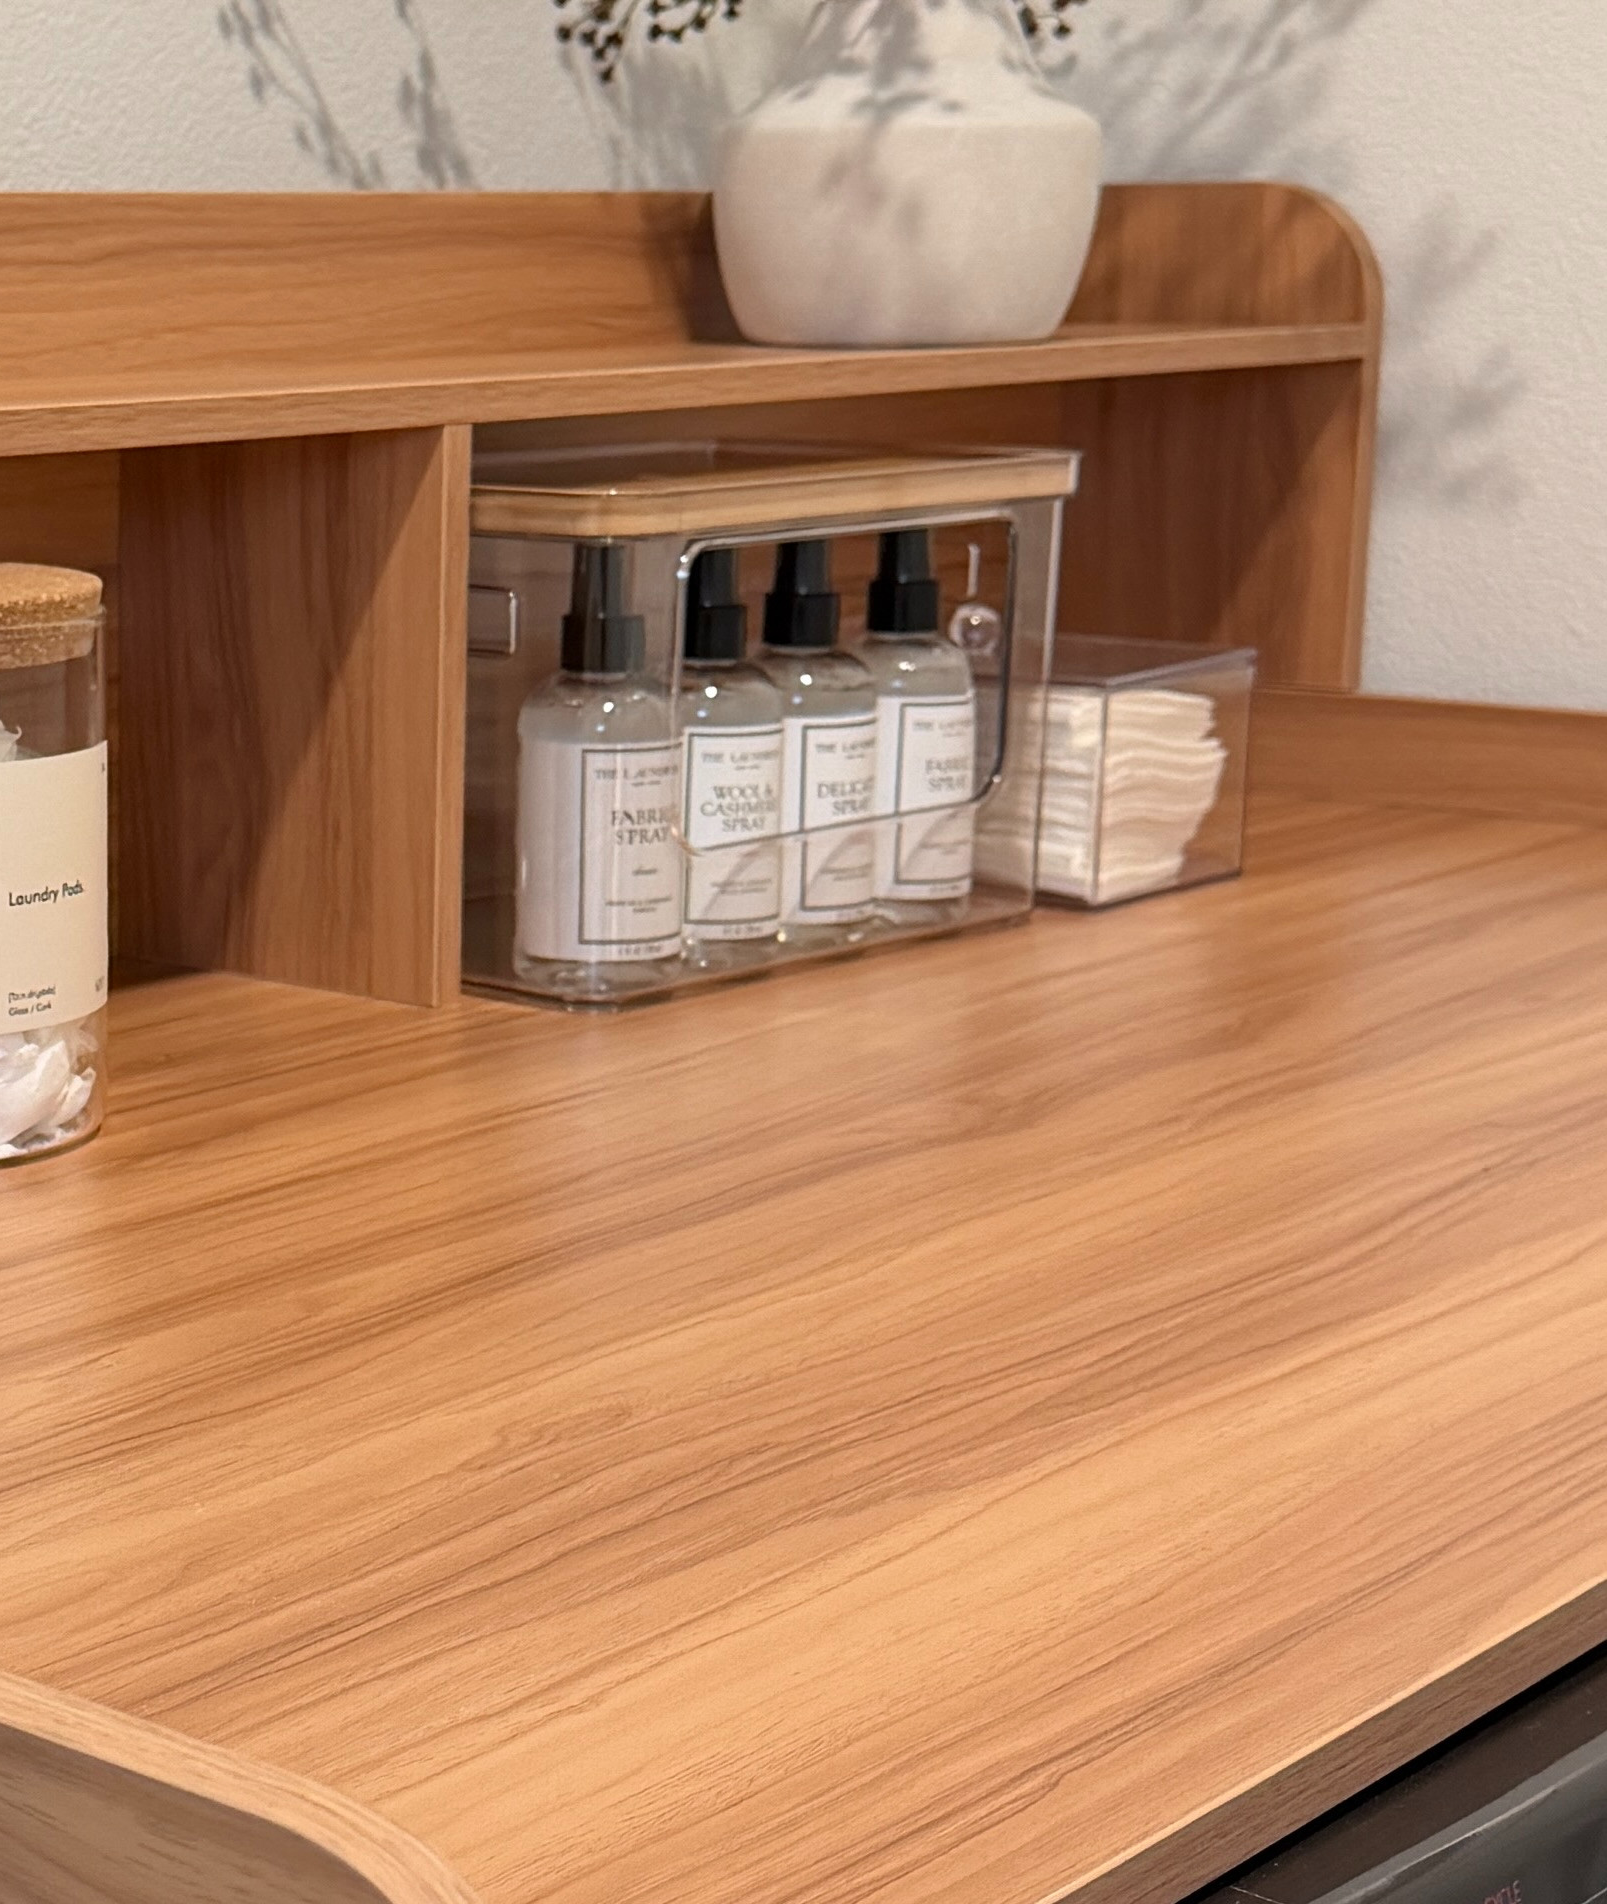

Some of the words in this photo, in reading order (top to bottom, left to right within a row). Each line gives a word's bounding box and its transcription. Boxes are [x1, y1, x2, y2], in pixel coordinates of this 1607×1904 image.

[722, 816, 766, 833] SPRAY
[615, 826, 669, 846] SPRAY
[9, 886, 58, 907] Laundry
